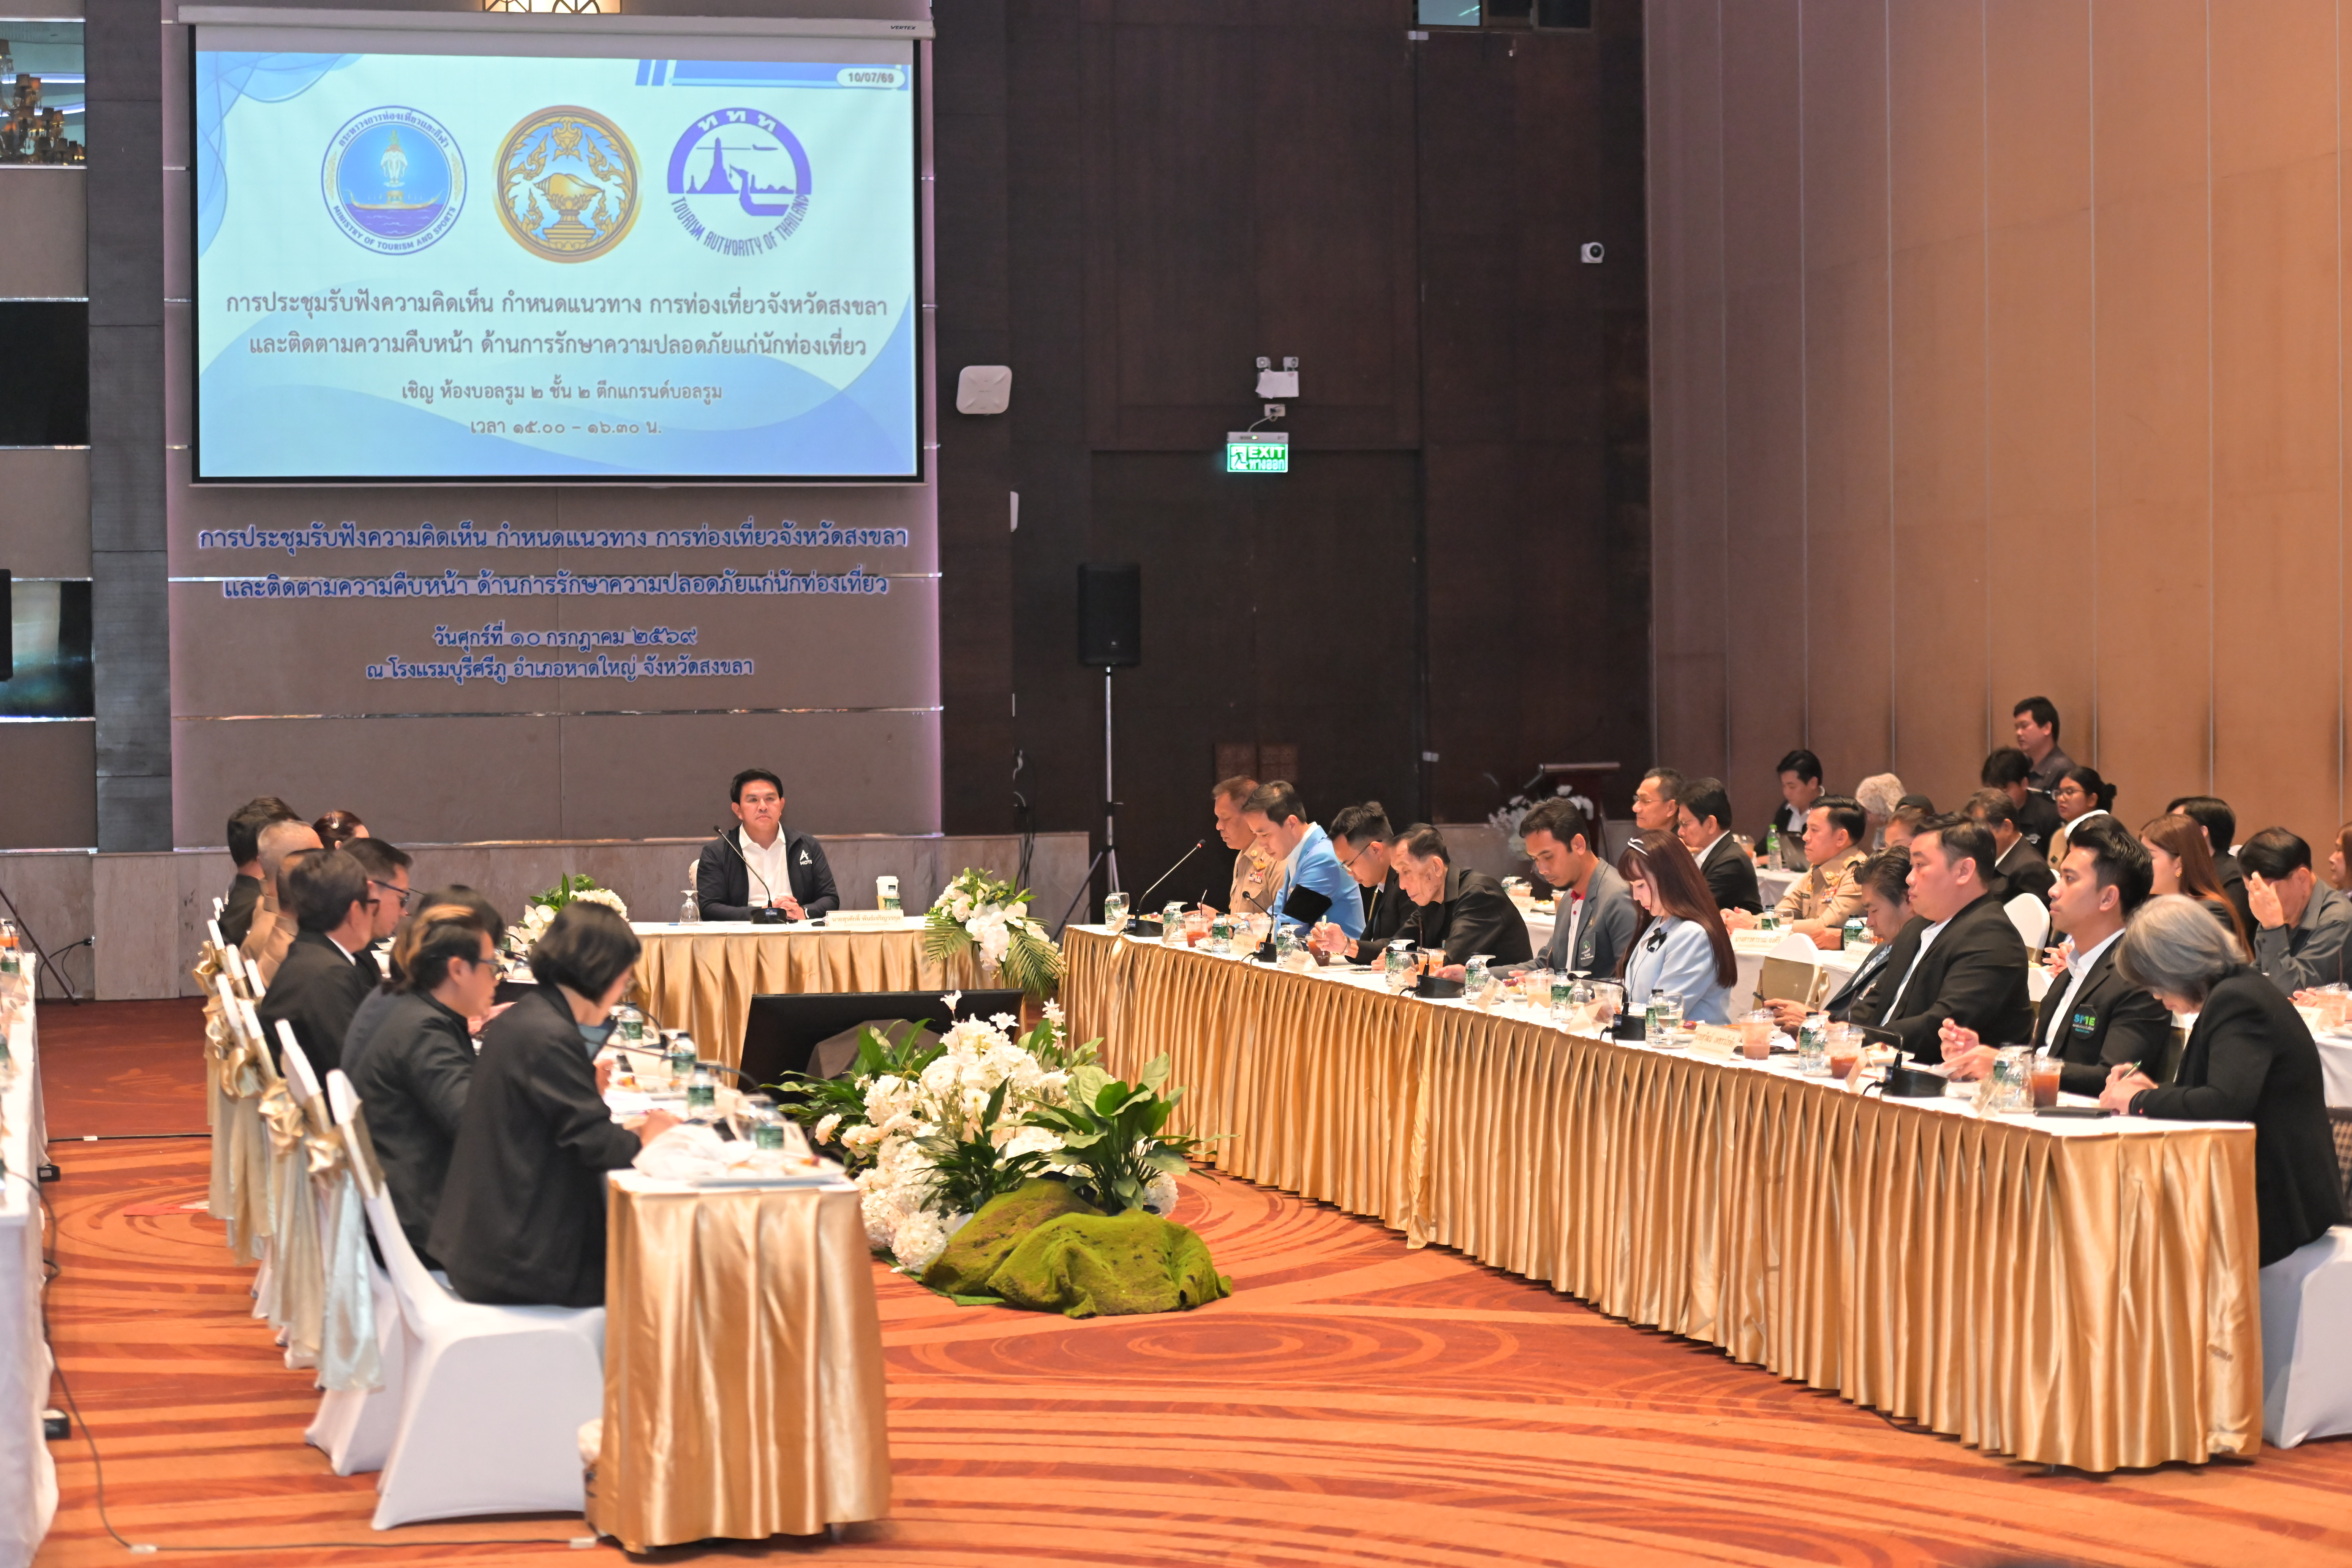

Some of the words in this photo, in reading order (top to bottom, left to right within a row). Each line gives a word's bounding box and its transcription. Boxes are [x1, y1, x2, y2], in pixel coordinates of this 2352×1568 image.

[848, 72, 894, 83] 10/07/69
[333, 205, 363, 239] MINISTRY
[364, 237, 375, 246] OF
[377, 241, 414, 251] TOURISM
[417, 234, 433, 246] AND
[435, 206, 457, 235] SPORTS
[671, 197, 705, 241] TOURISM
[703, 231, 763, 256] AUTHORITY
[763, 231, 777, 249] OF
[775, 194, 809, 240] THAILAND
[227, 288, 493, 319] การประชุมรับฟังความคิดเห็น
[502, 289, 642, 313] กำหนดแนวทาง
[650, 287, 887, 315] การท่องเที่ยวจังหวัดสงขลา
[250, 329, 473, 353] และติดตามความคืบหน้า
[481, 327, 866, 355] ด้านการรักษาความปลอดภัยแก่นักท่องเที่ยว
[402, 380, 433, 405] เชิญ
[440, 379, 525, 405] ห้องบอลรูม
[531, 386, 543, 398] ๒
[549, 375, 572, 398] ชั้น
[578, 386, 590, 398] ๒
[597, 380, 722, 405] ตึกแกรนด์บอลรูม
[471, 421, 505, 433] เวลา
[513, 420, 565, 434] ๑๕.๐๐
[646, 421, 662, 433] น.
[1248, 446, 1285, 458] EXIT
[1248, 459, 1285, 470] ทางออก
[200, 522, 487, 555] การประชุมรับฟังความคิดเห็น
[496, 523, 646, 546] กำหนดแนวทาง
[656, 517, 907, 546] การท่องเที่ยวจังหวัดสงขลา
[224, 570, 468, 596] และติดตามความคืบหน้า
[477, 565, 887, 594] ด้านการรักษาความปลอดภัยแก่นักท่องเที่ยว
[435, 622, 503, 652] วันศุกร์ที่
[511, 633, 541, 645] ๑๐
[547, 631, 624, 652] กรกฎาคม
[634, 628, 697, 644] ๒๕๖๙
[367, 665, 383, 677] ณ
[388, 656, 506, 684] โรงแรมบุรีศรีภู
[514, 656, 636, 681] อำเภอหาดใหญ่
[644, 655, 752, 675] จังหวัดสงขลา
